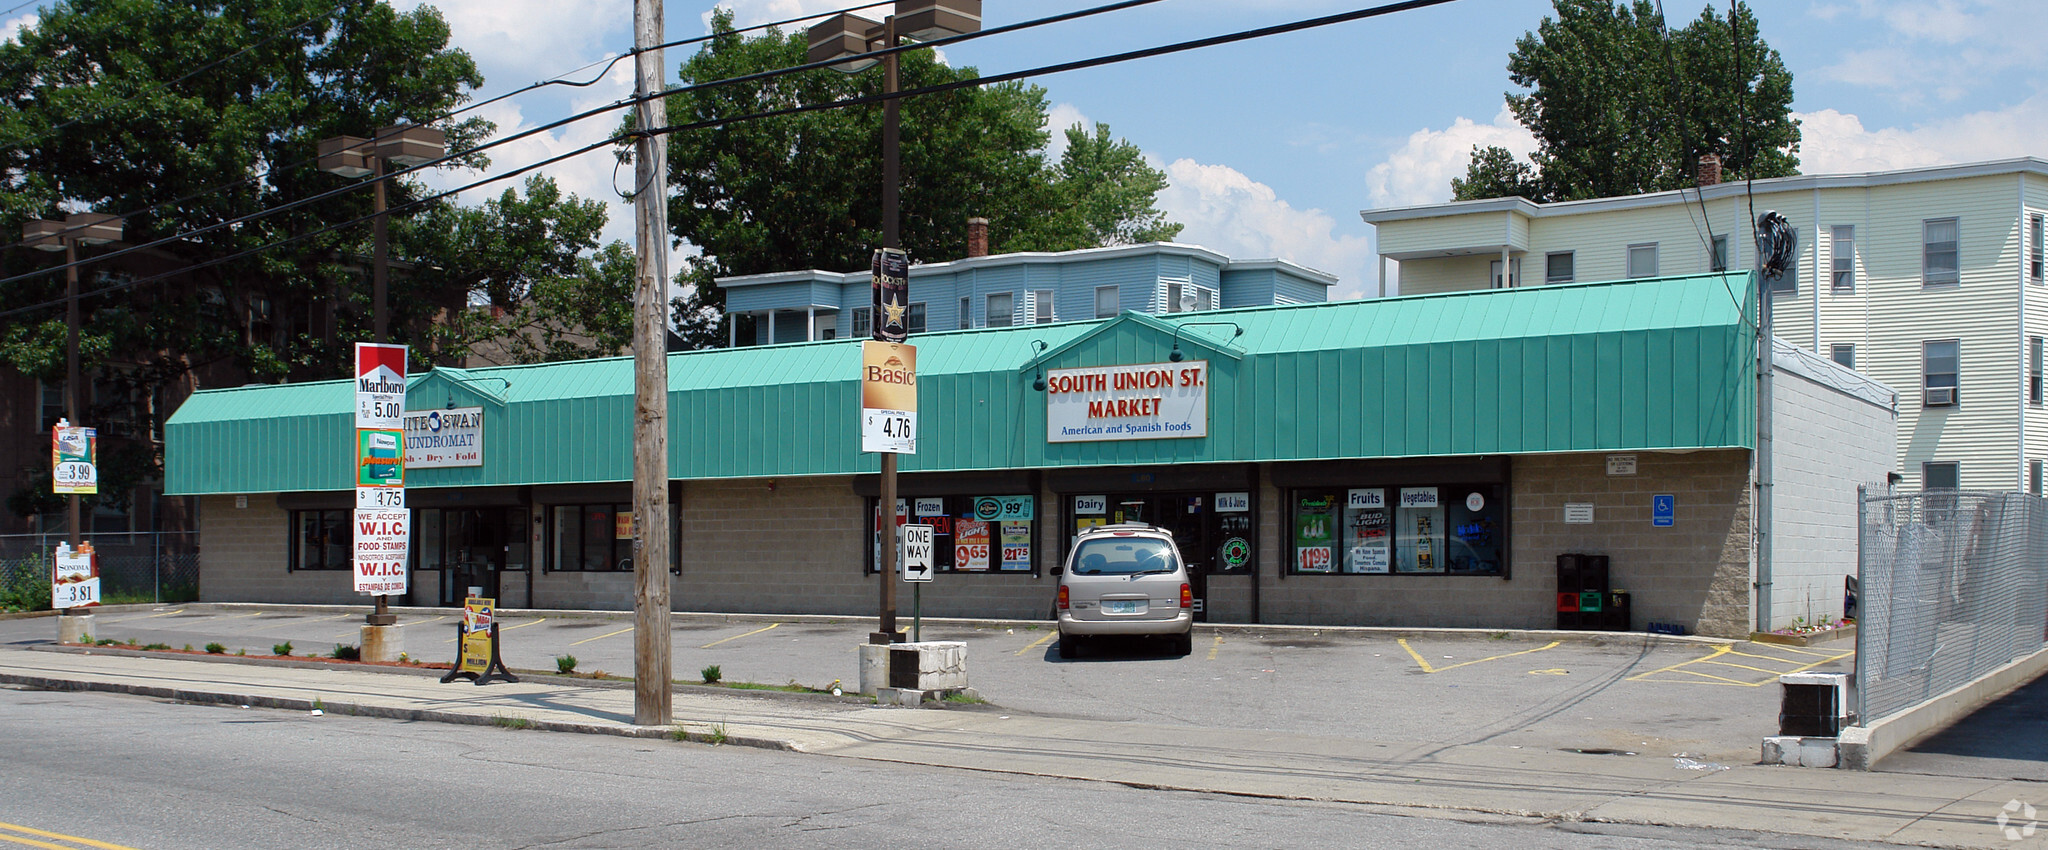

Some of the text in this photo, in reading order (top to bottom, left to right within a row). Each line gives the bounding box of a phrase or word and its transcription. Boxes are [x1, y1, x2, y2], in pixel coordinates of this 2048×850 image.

[868, 365, 915, 386] Basic
[1049, 368, 1204, 394] SOUTH UNION ST.
[359, 375, 404, 394] Marlboro
[374, 402, 400, 418] 5.00
[1088, 398, 1162, 419] MARKET
[442, 412, 481, 429] SWAN
[883, 417, 911, 438] 4.76
[1061, 421, 1192, 436] American and Spanish Foods
[426, 453, 444, 463] Dry
[455, 452, 477, 461] Fold
[360, 491, 366, 499] $
[1351, 493, 1380, 504] Fruits
[1402, 491, 1436, 505] Vegetables
[917, 502, 941, 512] Frozen
[1077, 500, 1104, 510] Dairy
[1222, 516, 1249, 529] ATM
[1356, 518, 1386, 526] LIGHT
[1360, 512, 1383, 520] BUD
[359, 522, 406, 536] W.I.C.
[907, 529, 930, 543] ONE
[960, 526, 986, 540] LIGHT
[382, 542, 406, 550] STAMPS
[906, 545, 930, 559] WAY
[360, 562, 404, 576] W.I.C.
[464, 644, 468, 653] $
